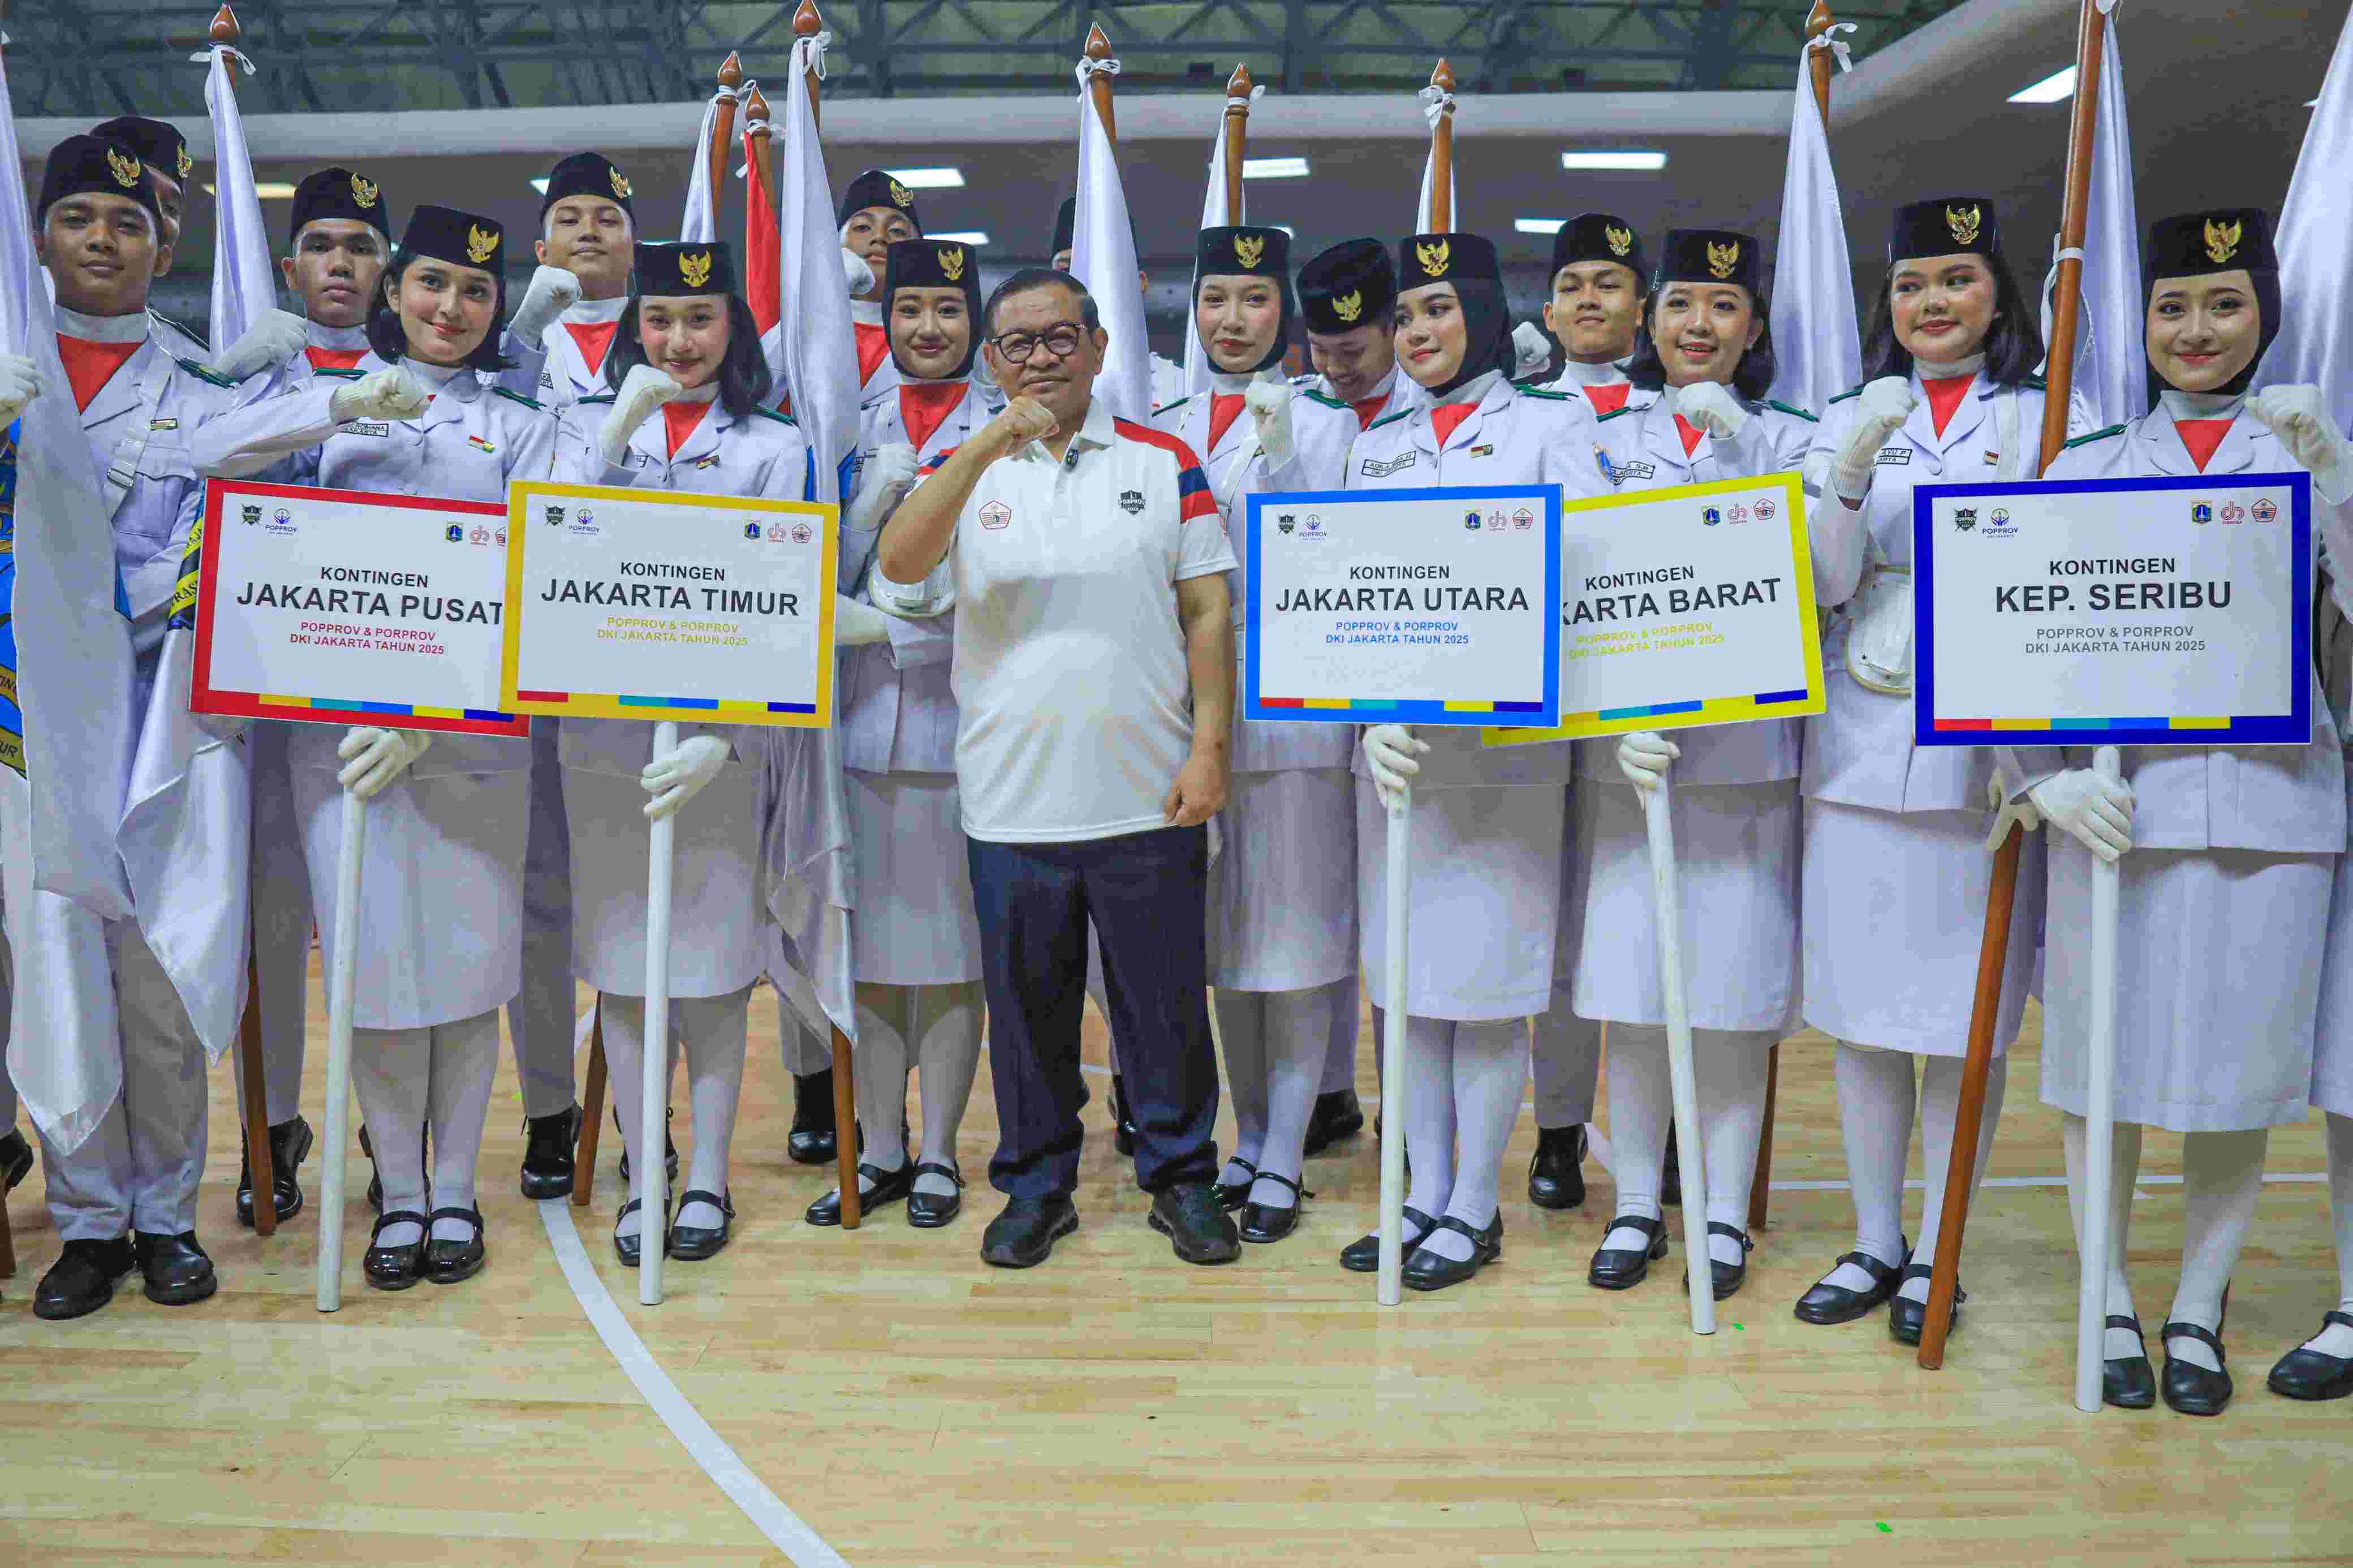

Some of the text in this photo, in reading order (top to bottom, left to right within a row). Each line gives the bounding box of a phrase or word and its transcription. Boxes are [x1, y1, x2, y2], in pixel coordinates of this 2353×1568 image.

[621, 562, 725, 581] KONTINGEN
[1350, 565, 1450, 579] KONTINGEN
[2050, 558, 2175, 576] KONTINGEN
[321, 567, 428, 588] KONTINGEN
[1585, 566, 1695, 591] KONTINGEN
[237, 582, 503, 625] JAKARTA PUSAT
[541, 579, 799, 616] JAKARTA TIMUR
[1276, 587, 1529, 611] JAKARTA UTARA
[1669, 578, 1781, 614] BARAT
[1996, 581, 2231, 612] KEP. SERIBU
[301, 622, 436, 641] POPPROV & PORPROV
[607, 617, 738, 633] POPPROV & PORPROV
[1336, 621, 1458, 631] POPPROV & PORPROV
[1576, 623, 1713, 645] POPPROV & PORPROV
[2037, 625, 2193, 639] POPPROV & PORPROV
[290, 633, 444, 655] DKI JAKARTA TAHUN 2025
[597, 629, 747, 645] DKI JAKARTA TAHUN 2025
[1326, 634, 1469, 644] DKI JAKARTA TAHUN 2025
[1570, 633, 1725, 660] DKI JAKARTA TAHUN 2025
[2026, 640, 2205, 654] DKI JAKARTA TAHUN 2025
